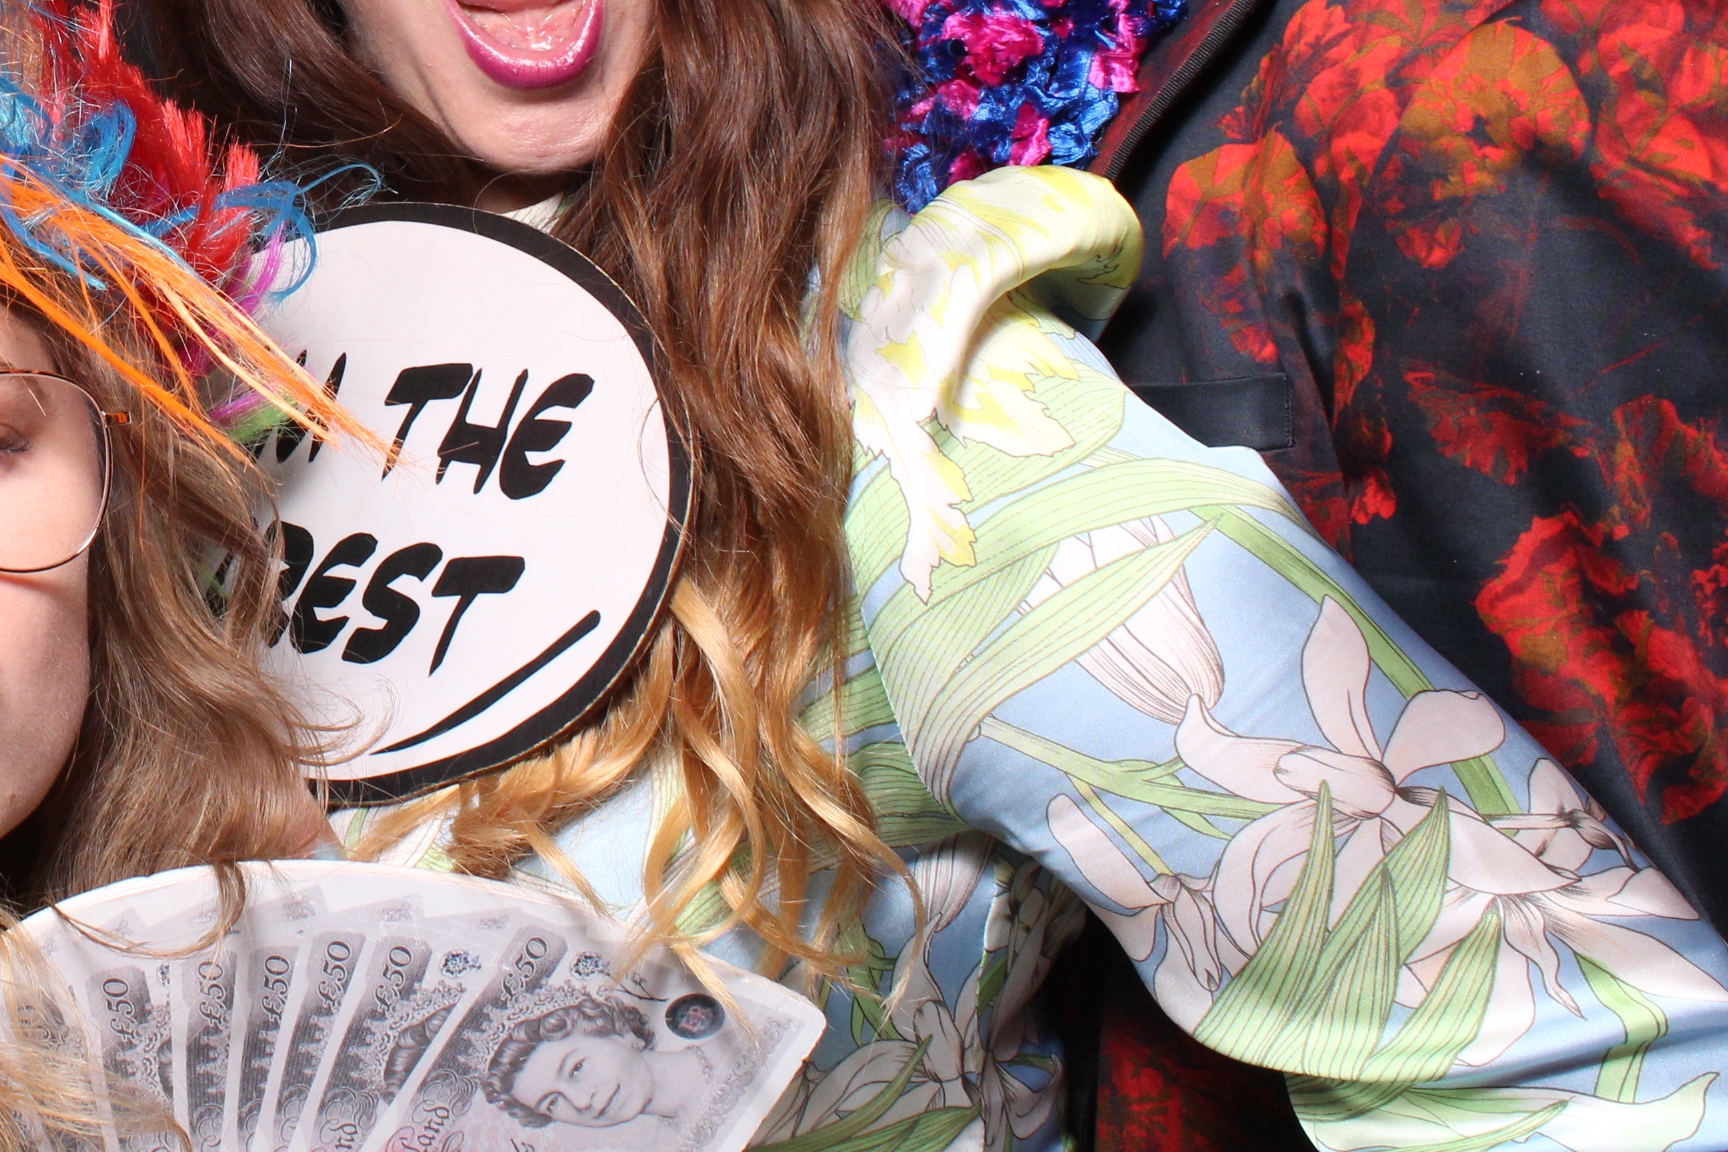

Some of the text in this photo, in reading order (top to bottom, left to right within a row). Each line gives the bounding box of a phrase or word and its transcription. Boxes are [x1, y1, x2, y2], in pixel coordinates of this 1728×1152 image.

[381, 362, 596, 501] THE
[197, 960, 227, 1029] £50
[260, 954, 290, 1024] £50
[318, 940, 351, 1009] £50
[375, 945, 413, 1013] £50
[501, 936, 548, 1000] £50
[102, 977, 139, 1044] £50
